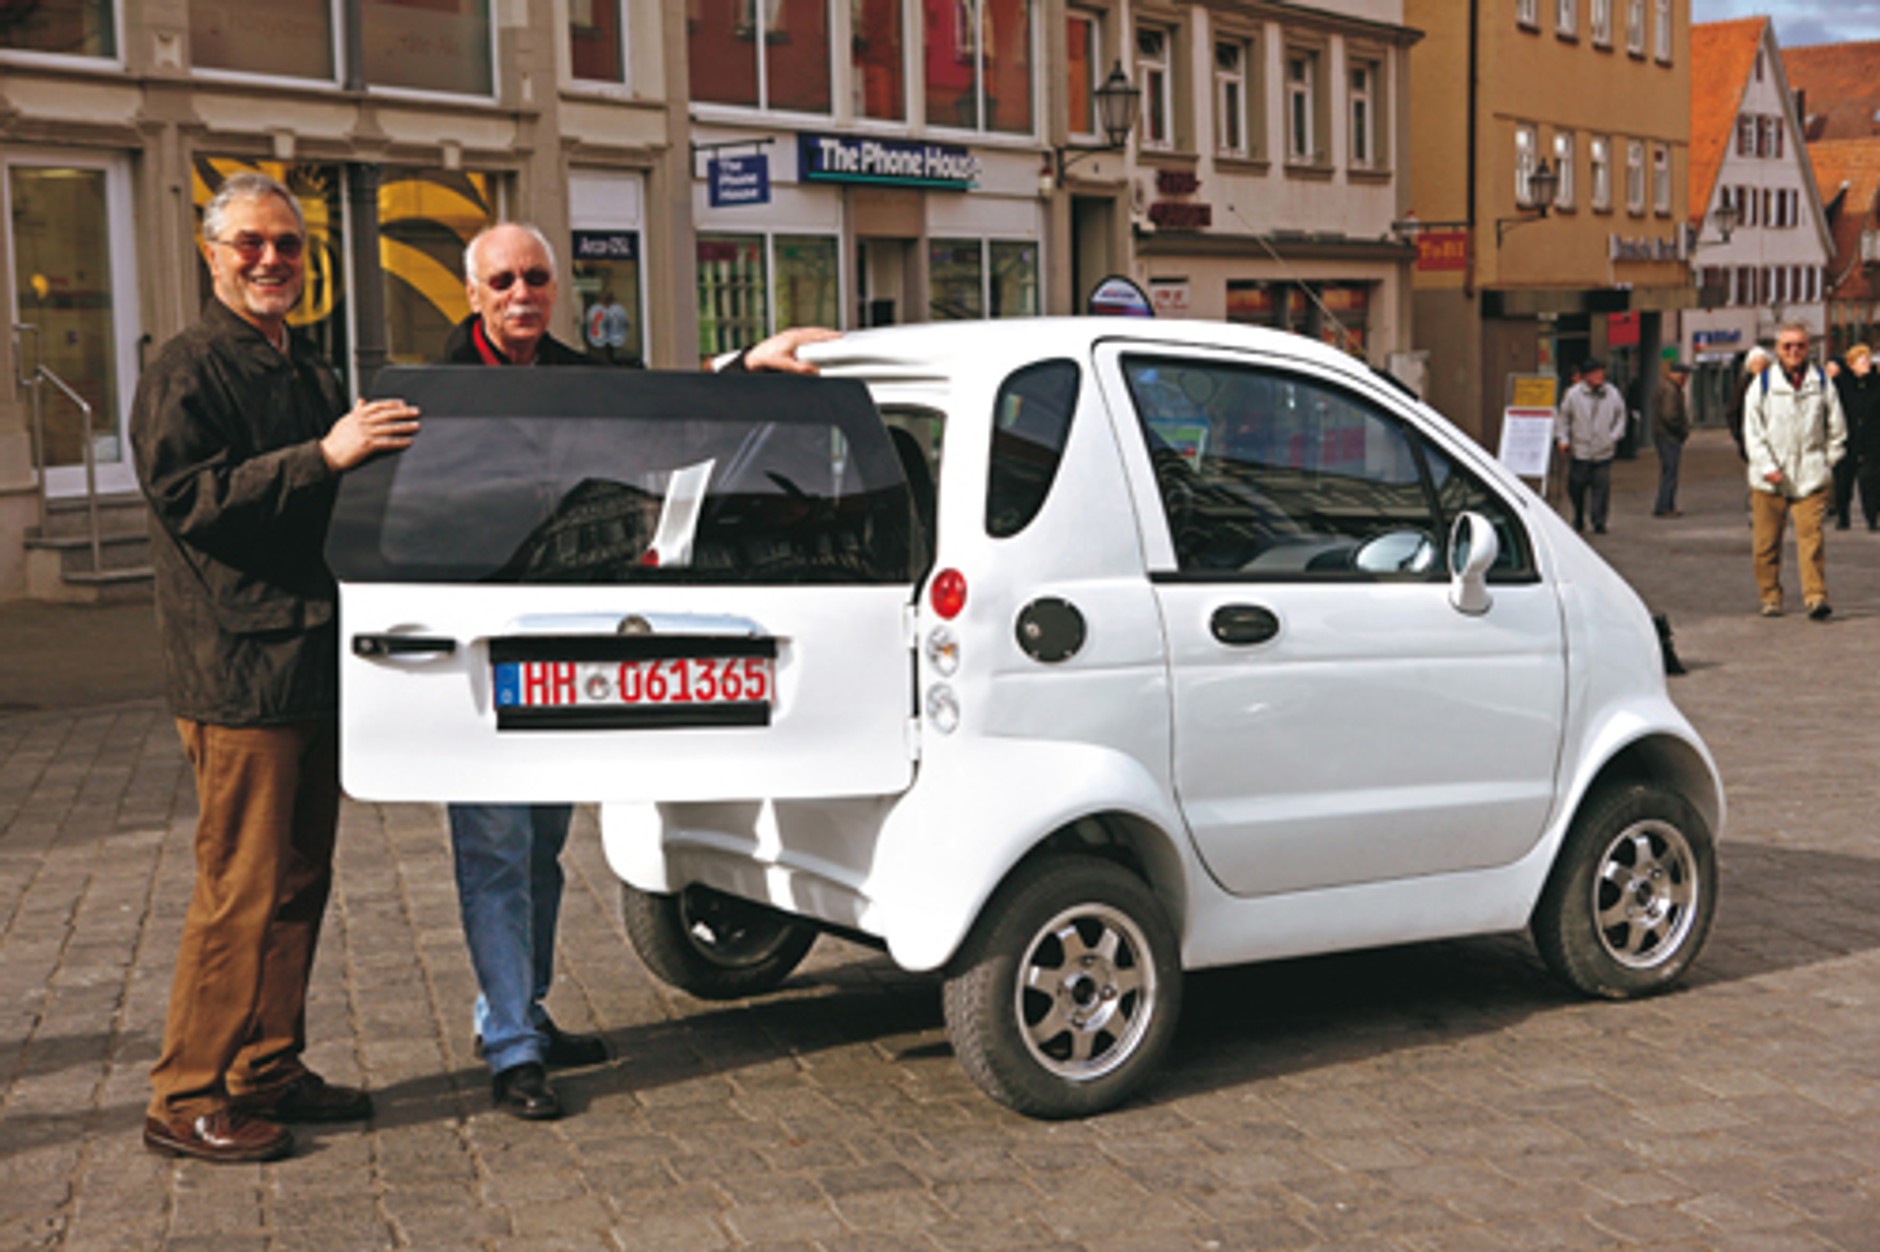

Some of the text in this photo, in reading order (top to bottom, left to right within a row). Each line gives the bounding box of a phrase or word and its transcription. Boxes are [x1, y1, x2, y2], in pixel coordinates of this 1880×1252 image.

[818, 138, 859, 172] The
[860, 141, 923, 176] Phone
[524, 657, 767, 706] HH 061365
